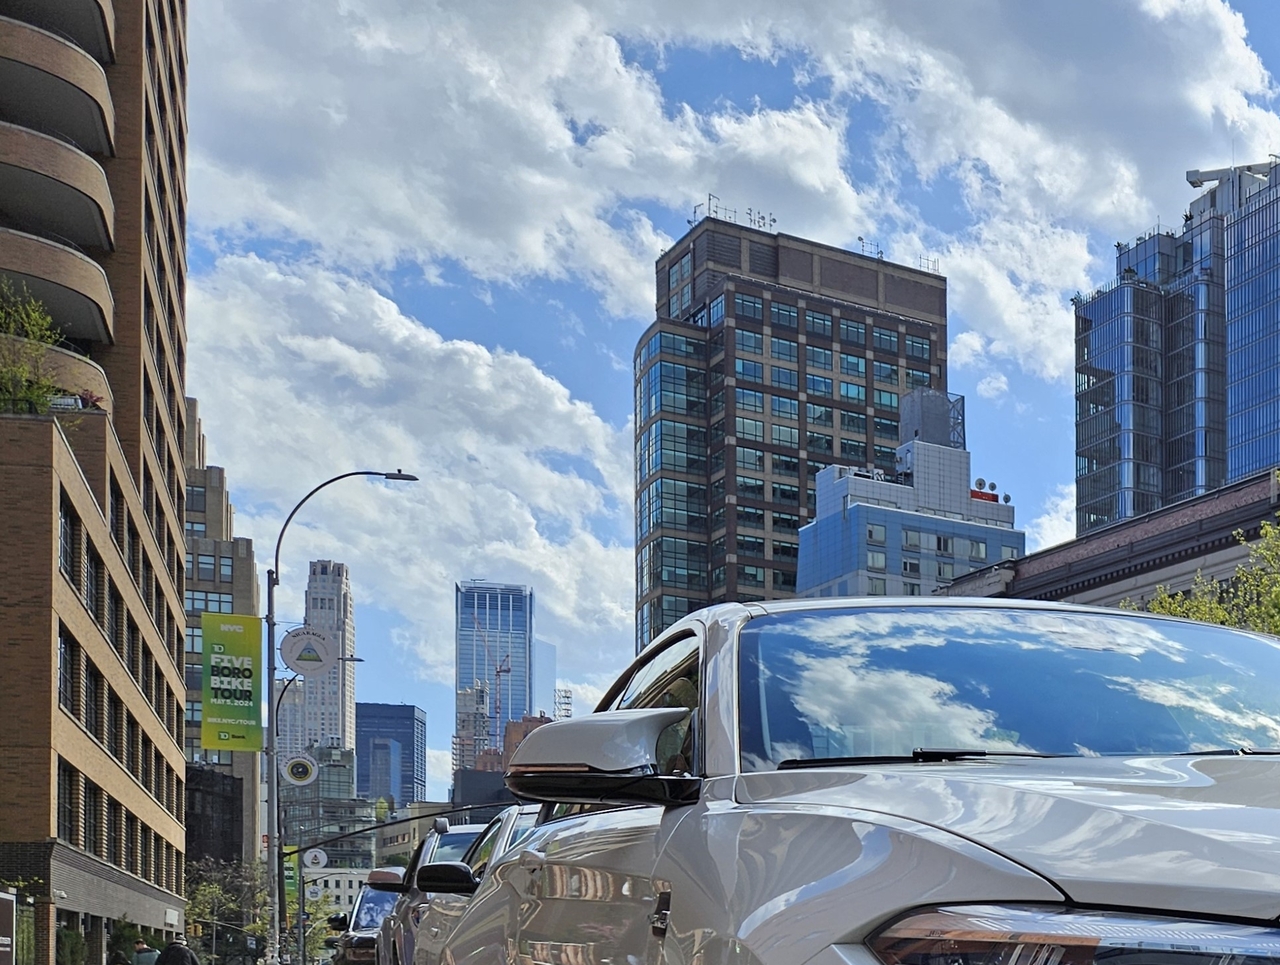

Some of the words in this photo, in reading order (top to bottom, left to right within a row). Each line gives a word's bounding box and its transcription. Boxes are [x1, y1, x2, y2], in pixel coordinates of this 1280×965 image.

[220, 624, 244, 633] NYC
[210, 654, 252, 669] FIVE
[210, 665, 254, 680] BORO
[210, 676, 253, 691] BIKE
[210, 687, 253, 701] TOUR
